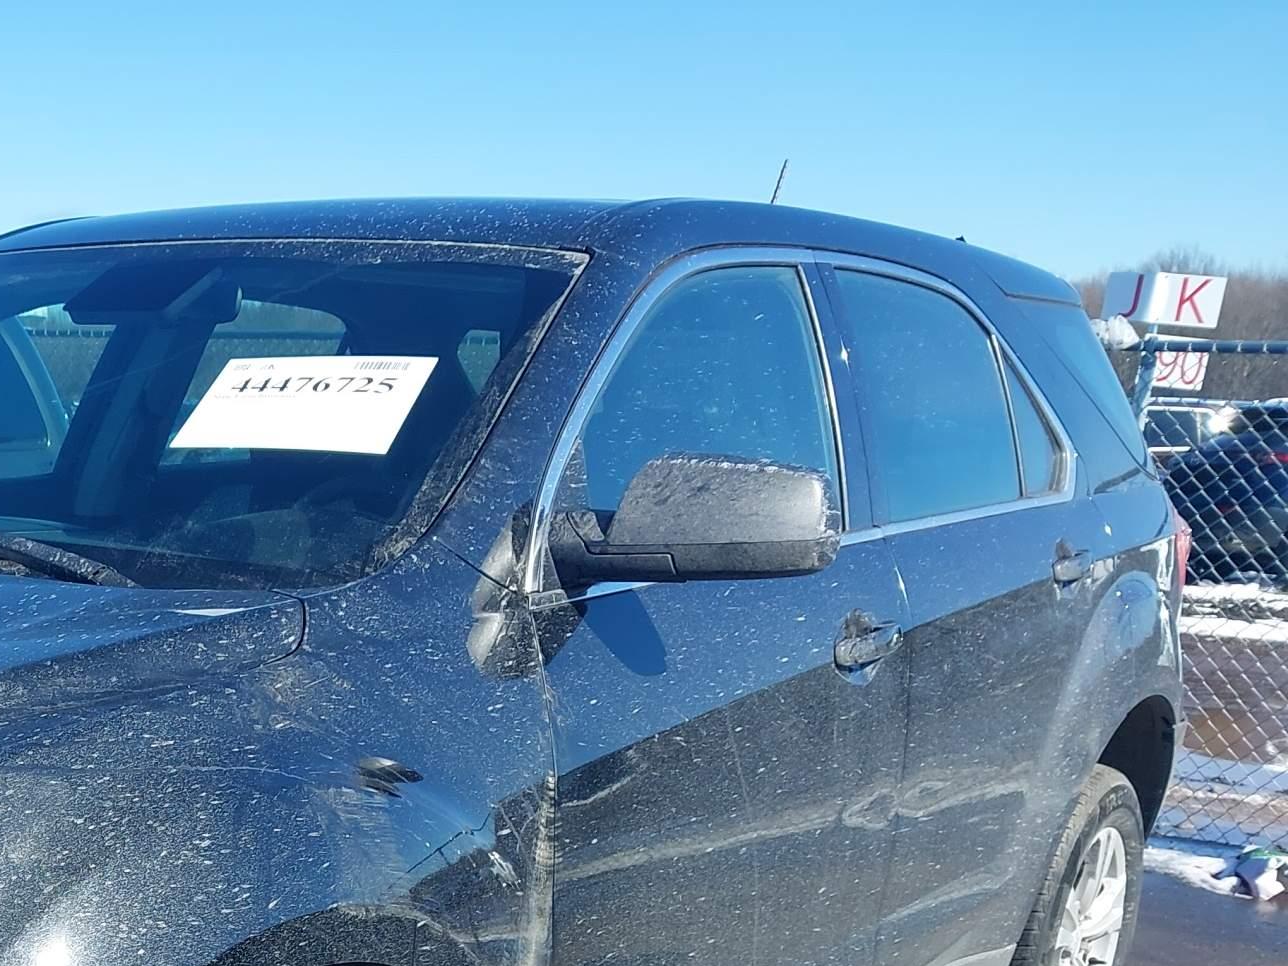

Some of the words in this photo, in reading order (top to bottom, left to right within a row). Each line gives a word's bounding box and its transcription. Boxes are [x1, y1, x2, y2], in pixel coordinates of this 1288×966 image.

[1118, 274, 1144, 318] J
[1175, 277, 1213, 323] K
[231, 377, 399, 393] 44476725
